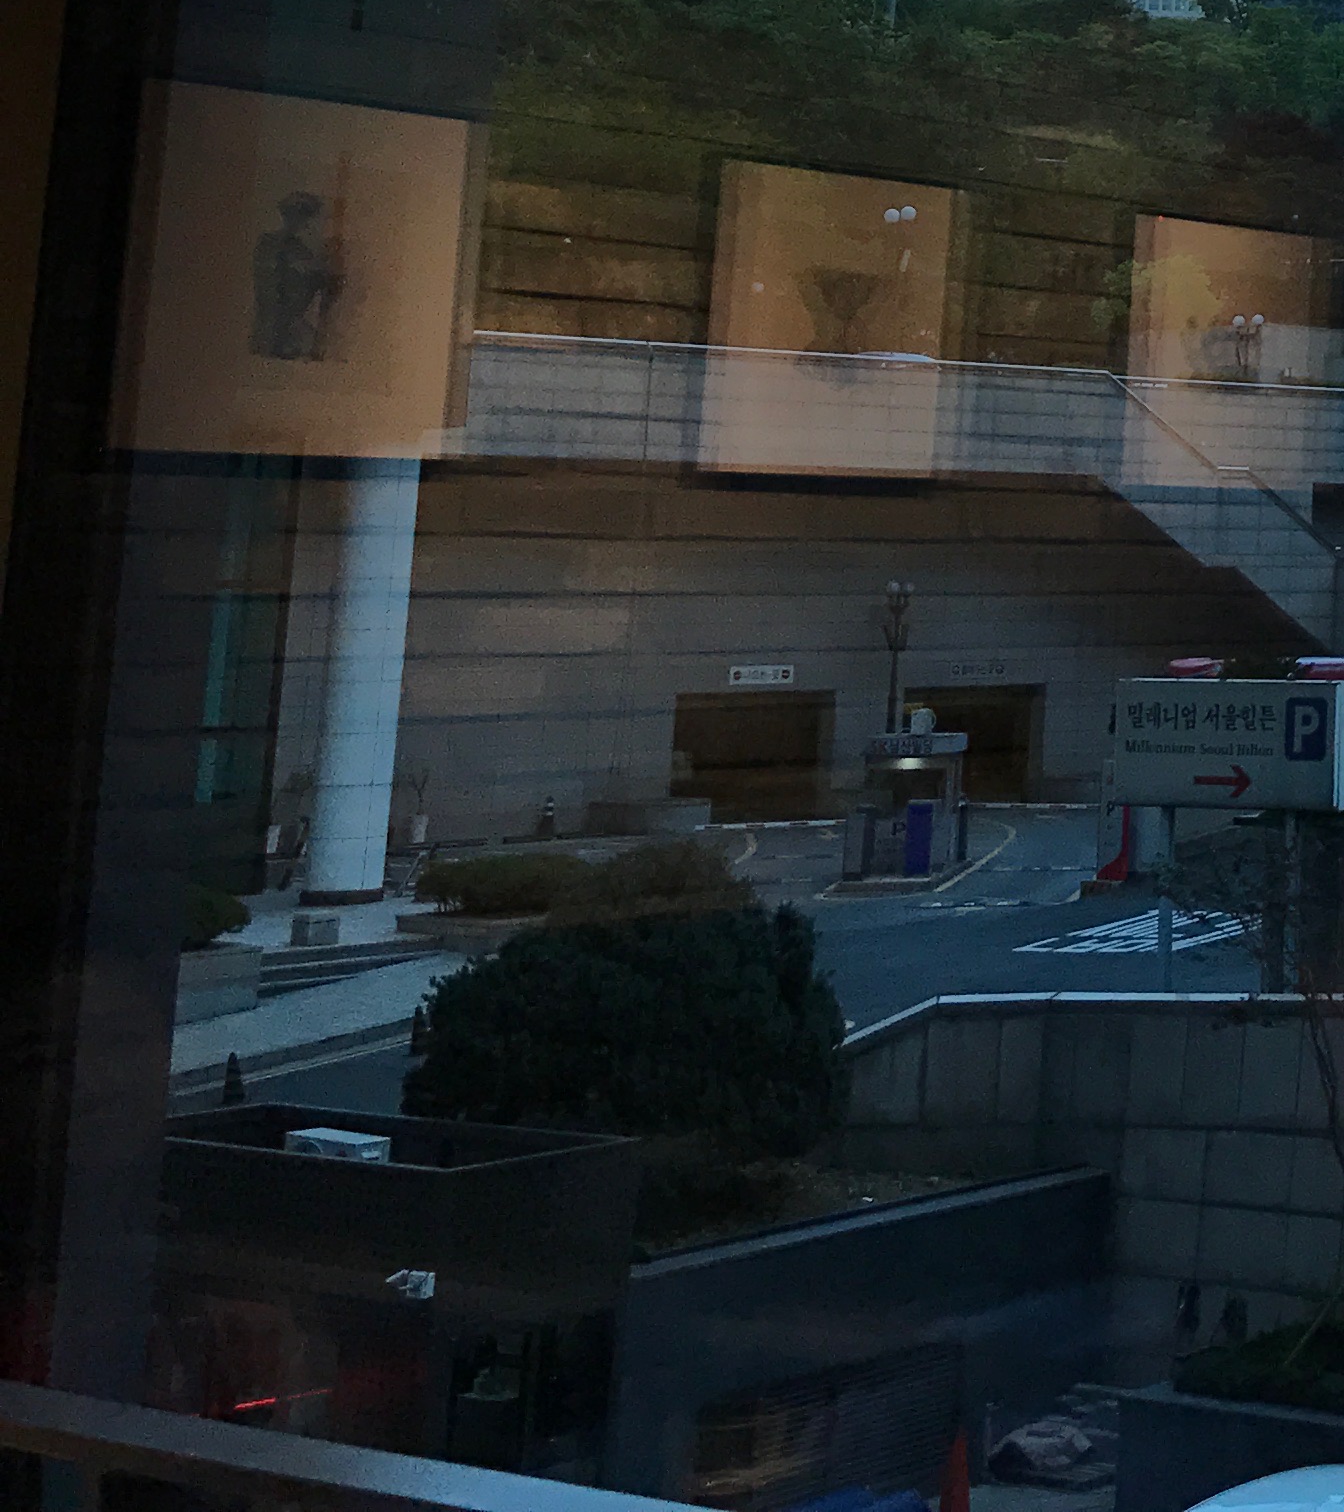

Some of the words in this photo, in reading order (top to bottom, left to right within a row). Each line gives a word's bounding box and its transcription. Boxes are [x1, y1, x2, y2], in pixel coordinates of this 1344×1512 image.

[1127, 701, 1197, 729] 밀레니엄
[1202, 703, 1276, 732] 서울힐튼
[1293, 707, 1319, 753] P
[1125, 740, 1195, 753] Millennium
[1200, 743, 1233, 755] Seoul
[1236, 744, 1273, 756] Hilton
